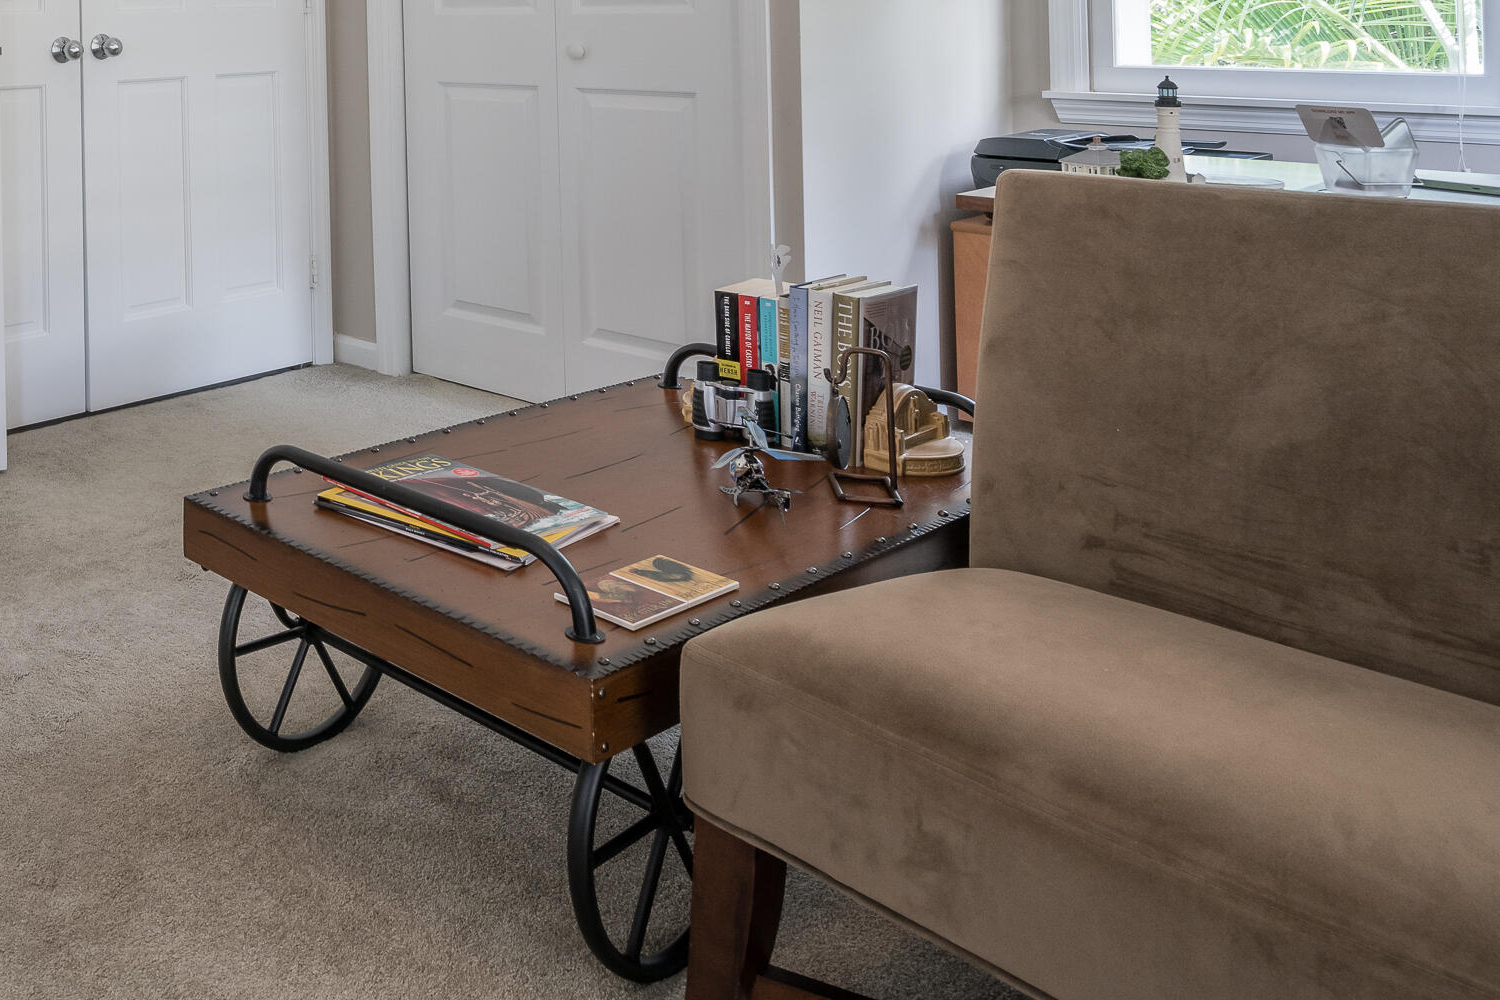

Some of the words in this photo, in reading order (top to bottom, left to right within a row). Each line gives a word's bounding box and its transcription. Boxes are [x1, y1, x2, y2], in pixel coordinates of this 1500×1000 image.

[743, 313, 752, 322] THE
[812, 300, 823, 328] NEIL
[837, 300, 854, 339] THE
[743, 323, 752, 341] MAYOR
[743, 341, 752, 349] OF
[812, 331, 823, 380] GAIMAN
[744, 349, 752, 368] CASTRO
[371, 457, 452, 481] KINGS
